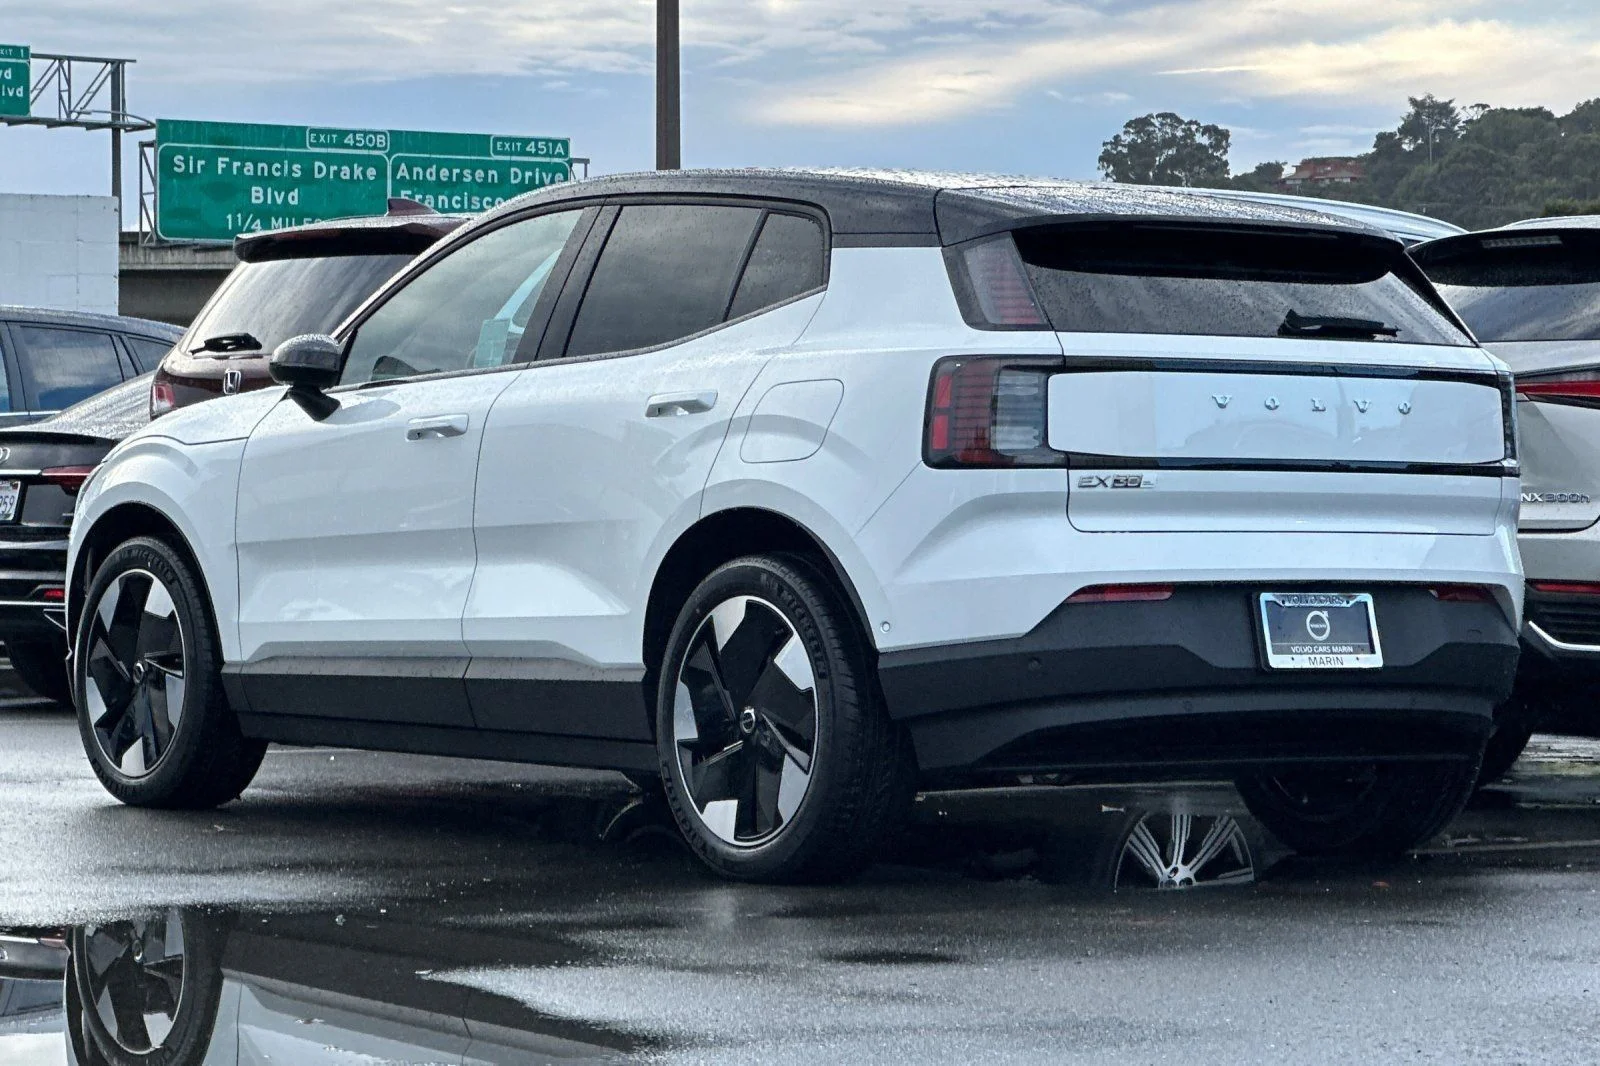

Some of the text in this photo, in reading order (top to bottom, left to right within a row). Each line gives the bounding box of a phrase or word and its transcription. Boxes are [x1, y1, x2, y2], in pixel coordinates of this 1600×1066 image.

[0, 48, 13, 56] XIT
[2, 84, 24, 97] lvd
[310, 134, 387, 148] EXIT 450B
[496, 141, 565, 156] EXIT 451A
[173, 155, 377, 181] Sir Francis Drake
[396, 162, 564, 185] Andersen Drive
[251, 186, 299, 205] Blvd
[1211, 394, 1412, 416] VOLVO
[1307, 656, 1345, 666] MARIN
